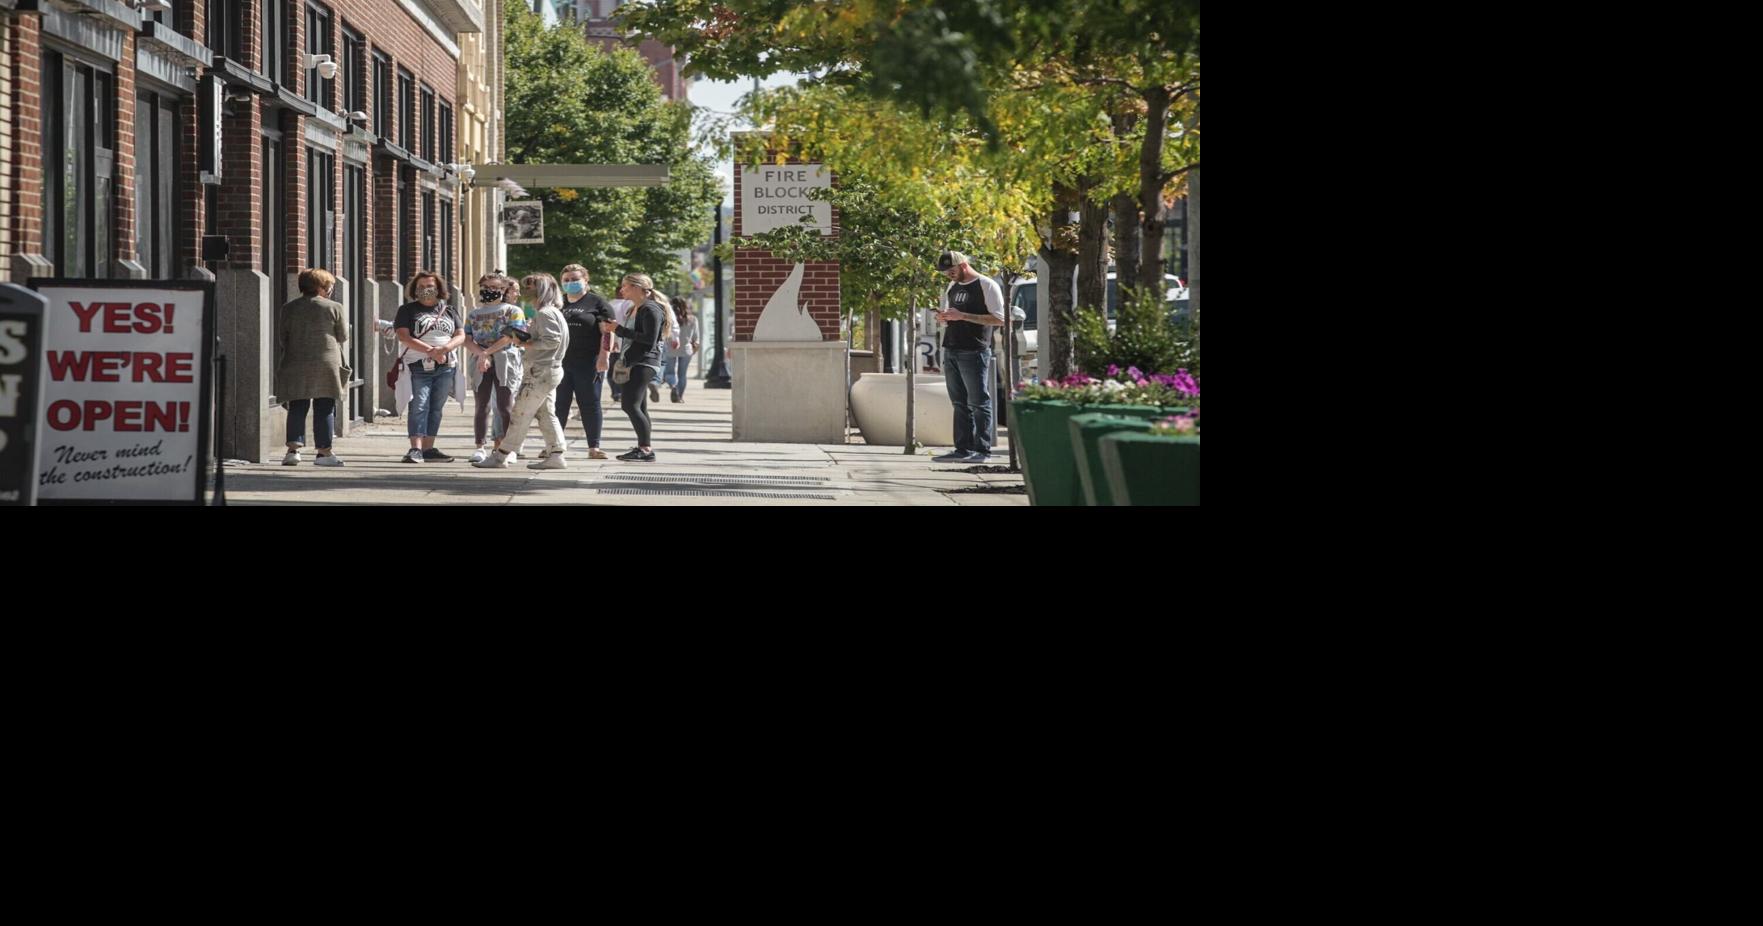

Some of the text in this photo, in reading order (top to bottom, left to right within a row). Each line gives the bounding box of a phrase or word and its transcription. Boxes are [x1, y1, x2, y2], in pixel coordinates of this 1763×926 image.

[765, 170, 807, 182] FIRE
[754, 187, 817, 199] BLOCK
[758, 205, 815, 215] DISTRICT
[68, 301, 175, 334] YES!
[47, 350, 193, 383] WE'RE
[46, 399, 190, 432] OPEN!
[54, 439, 163, 464] Never mind
[39, 455, 193, 485] the construction!
